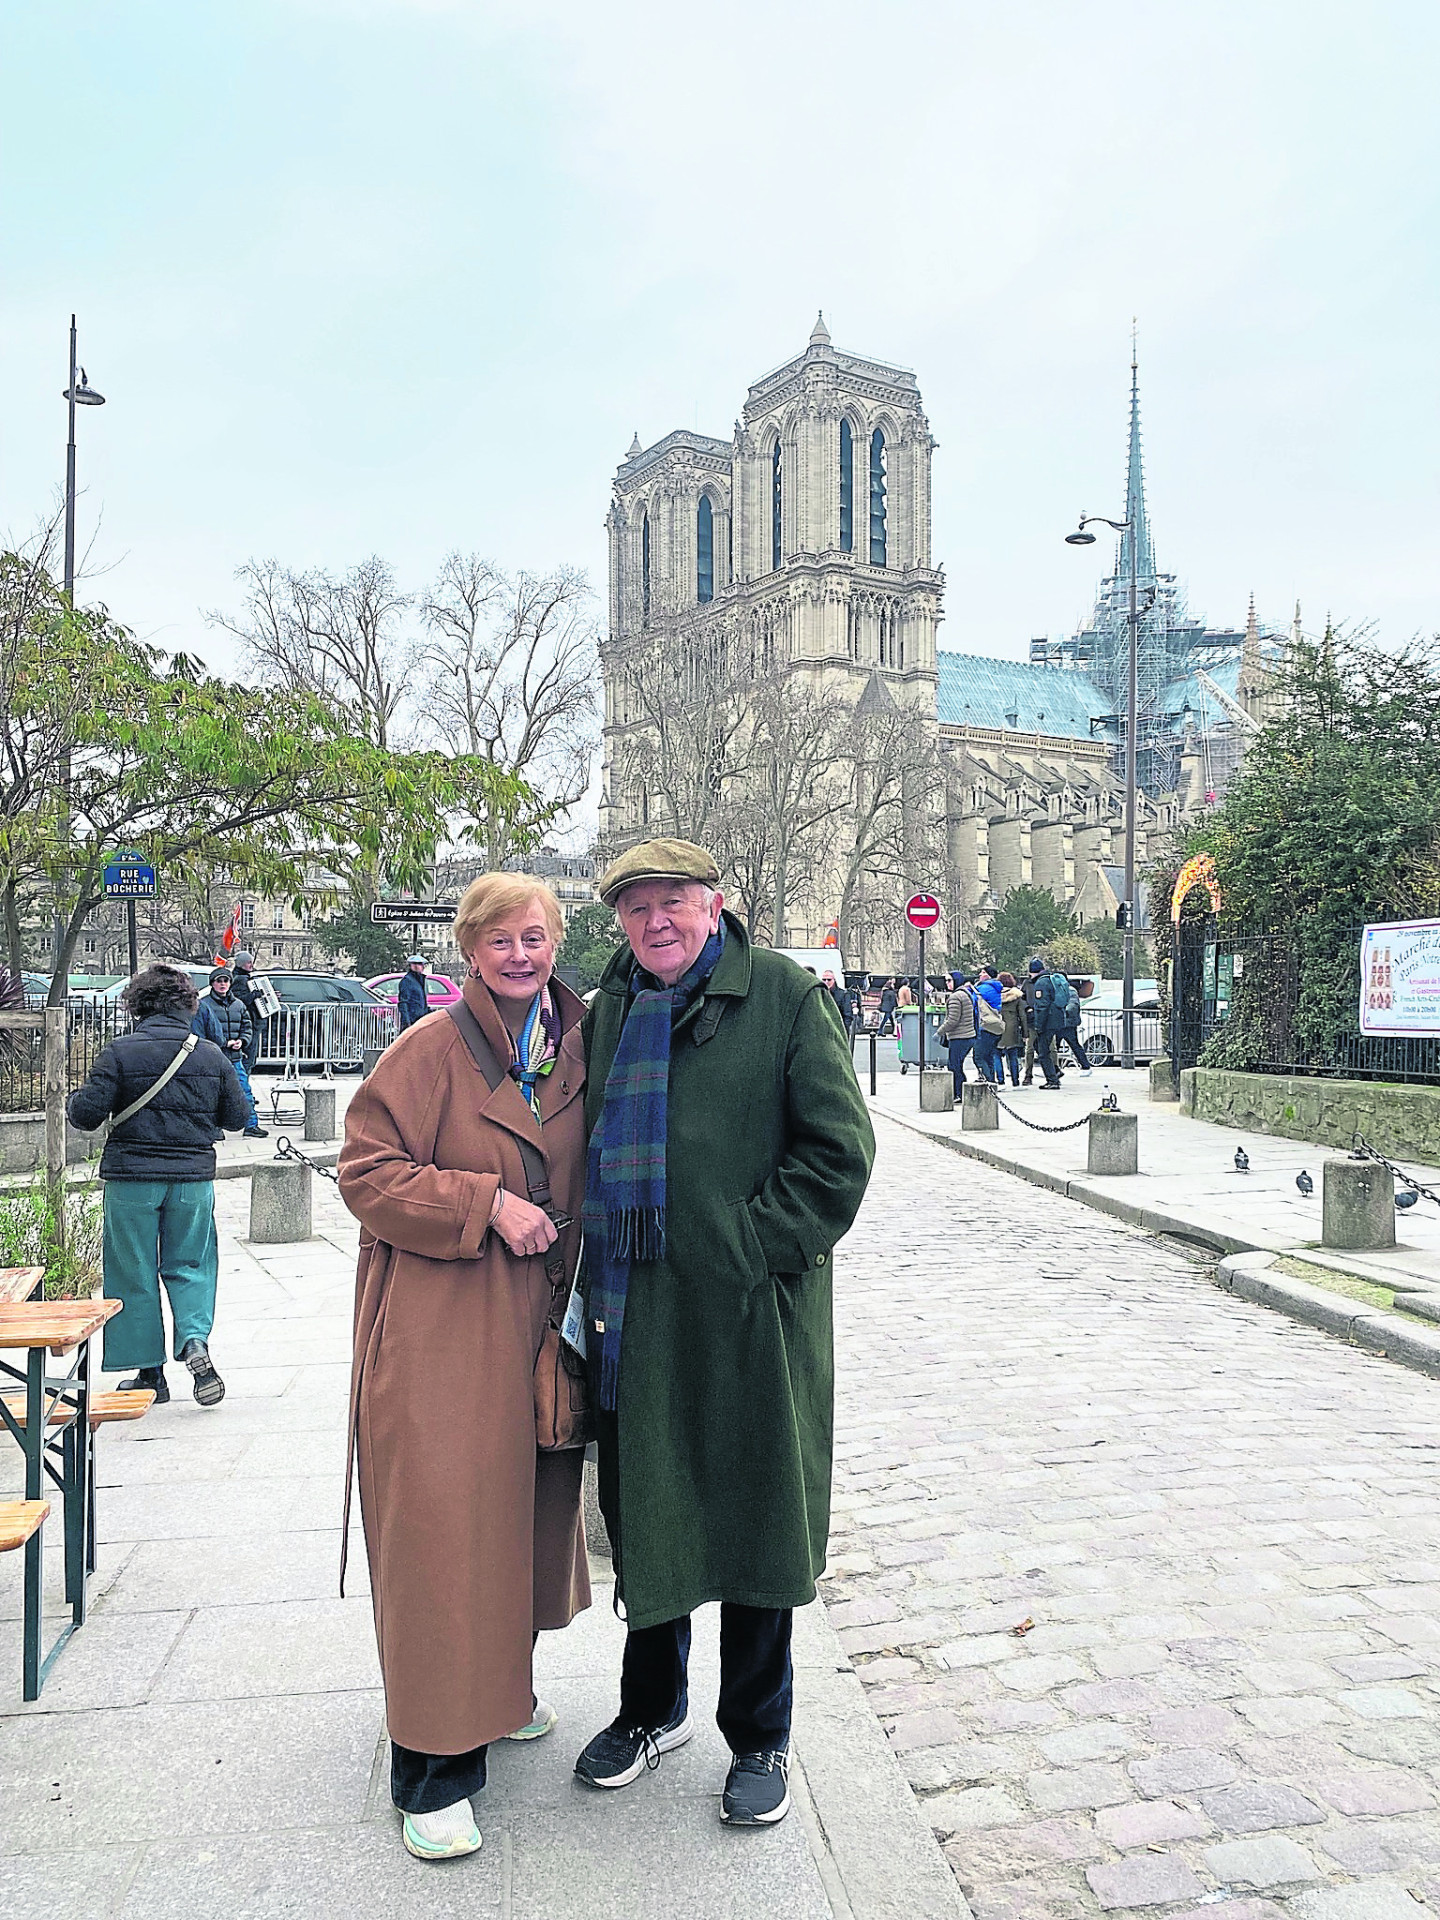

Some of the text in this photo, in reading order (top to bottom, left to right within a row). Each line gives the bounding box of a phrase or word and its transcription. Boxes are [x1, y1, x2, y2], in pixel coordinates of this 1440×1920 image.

[120, 870, 139, 878] RUE
[1392, 936, 1431, 972] Marché
[1400, 959, 1419, 981] Paris
